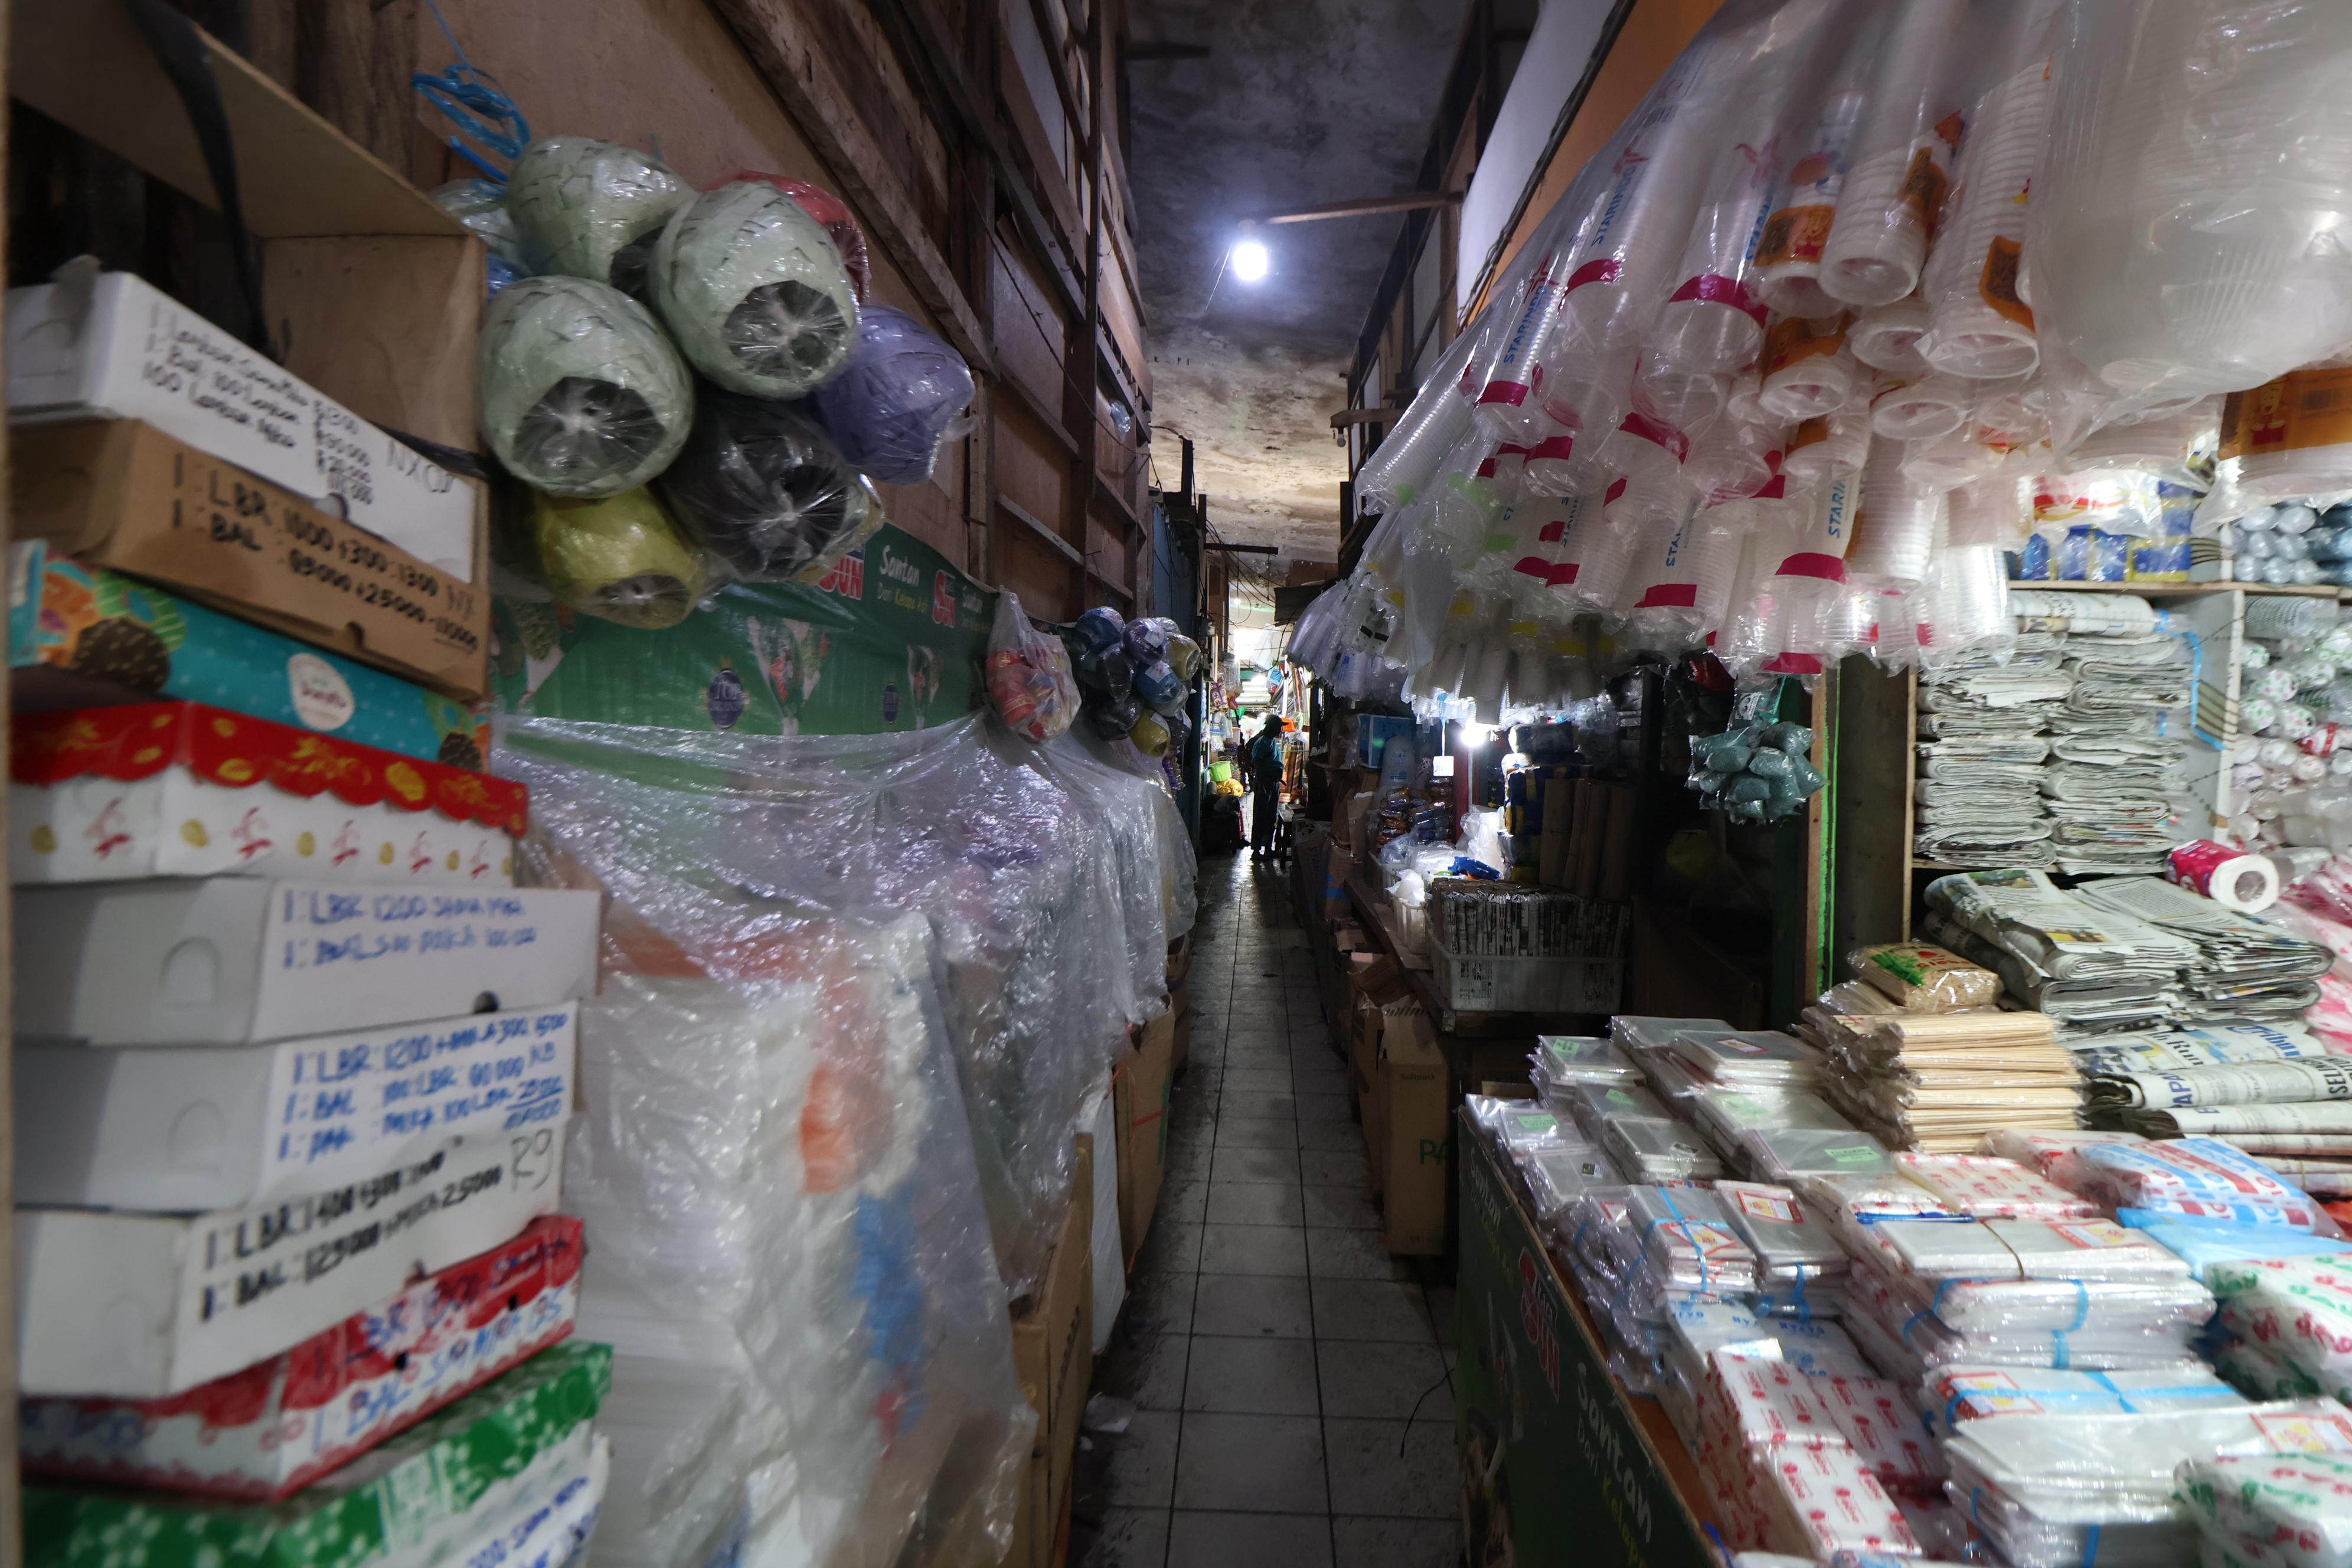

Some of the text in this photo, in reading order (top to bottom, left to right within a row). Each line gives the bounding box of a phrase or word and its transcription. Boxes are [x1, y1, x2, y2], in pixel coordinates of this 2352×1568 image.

[1591, 166, 1638, 247] STARINDO
[1503, 285, 1548, 364] STARINDO
[1577, 1361, 1652, 1544] Santan
